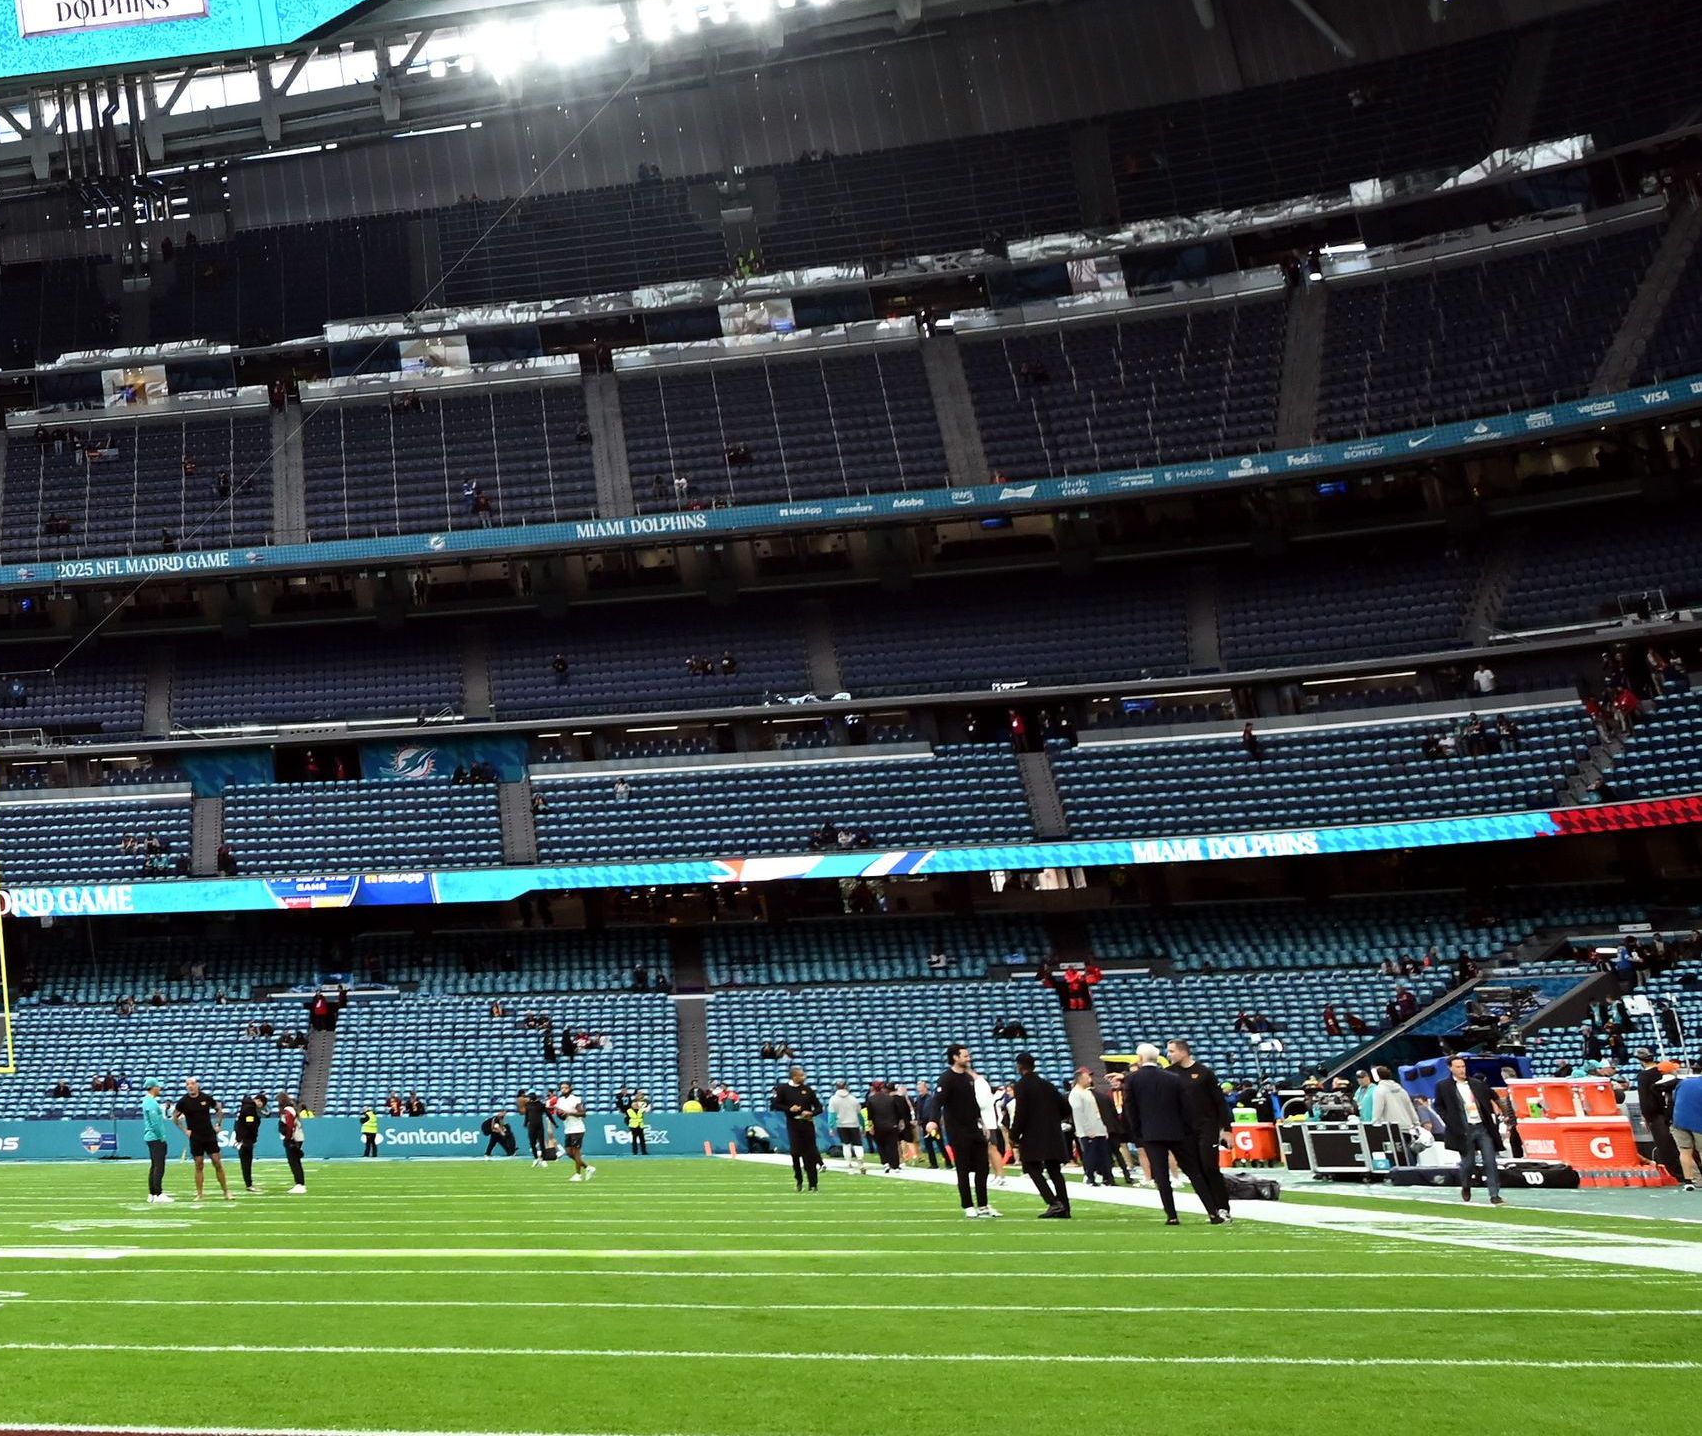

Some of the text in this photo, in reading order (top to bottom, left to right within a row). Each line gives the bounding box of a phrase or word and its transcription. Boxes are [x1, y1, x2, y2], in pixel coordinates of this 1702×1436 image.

[1640, 391, 1670, 404] VISA
[1576, 400, 1615, 414] verizon
[790, 505, 822, 516] NetApp
[893, 498, 924, 508] Adobe
[576, 514, 706, 539] MIAMI DOLPHINS
[57, 552, 229, 578] 2025 NFL MADRID GAME
[1131, 832, 1319, 863] MIAMI DOLPHINS
[296, 883, 327, 892] GAME
[57, 885, 134, 913] GAME
[386, 1128, 481, 1145] Santander
[1236, 1131, 1253, 1151] G
[1589, 1136, 1614, 1159] G
